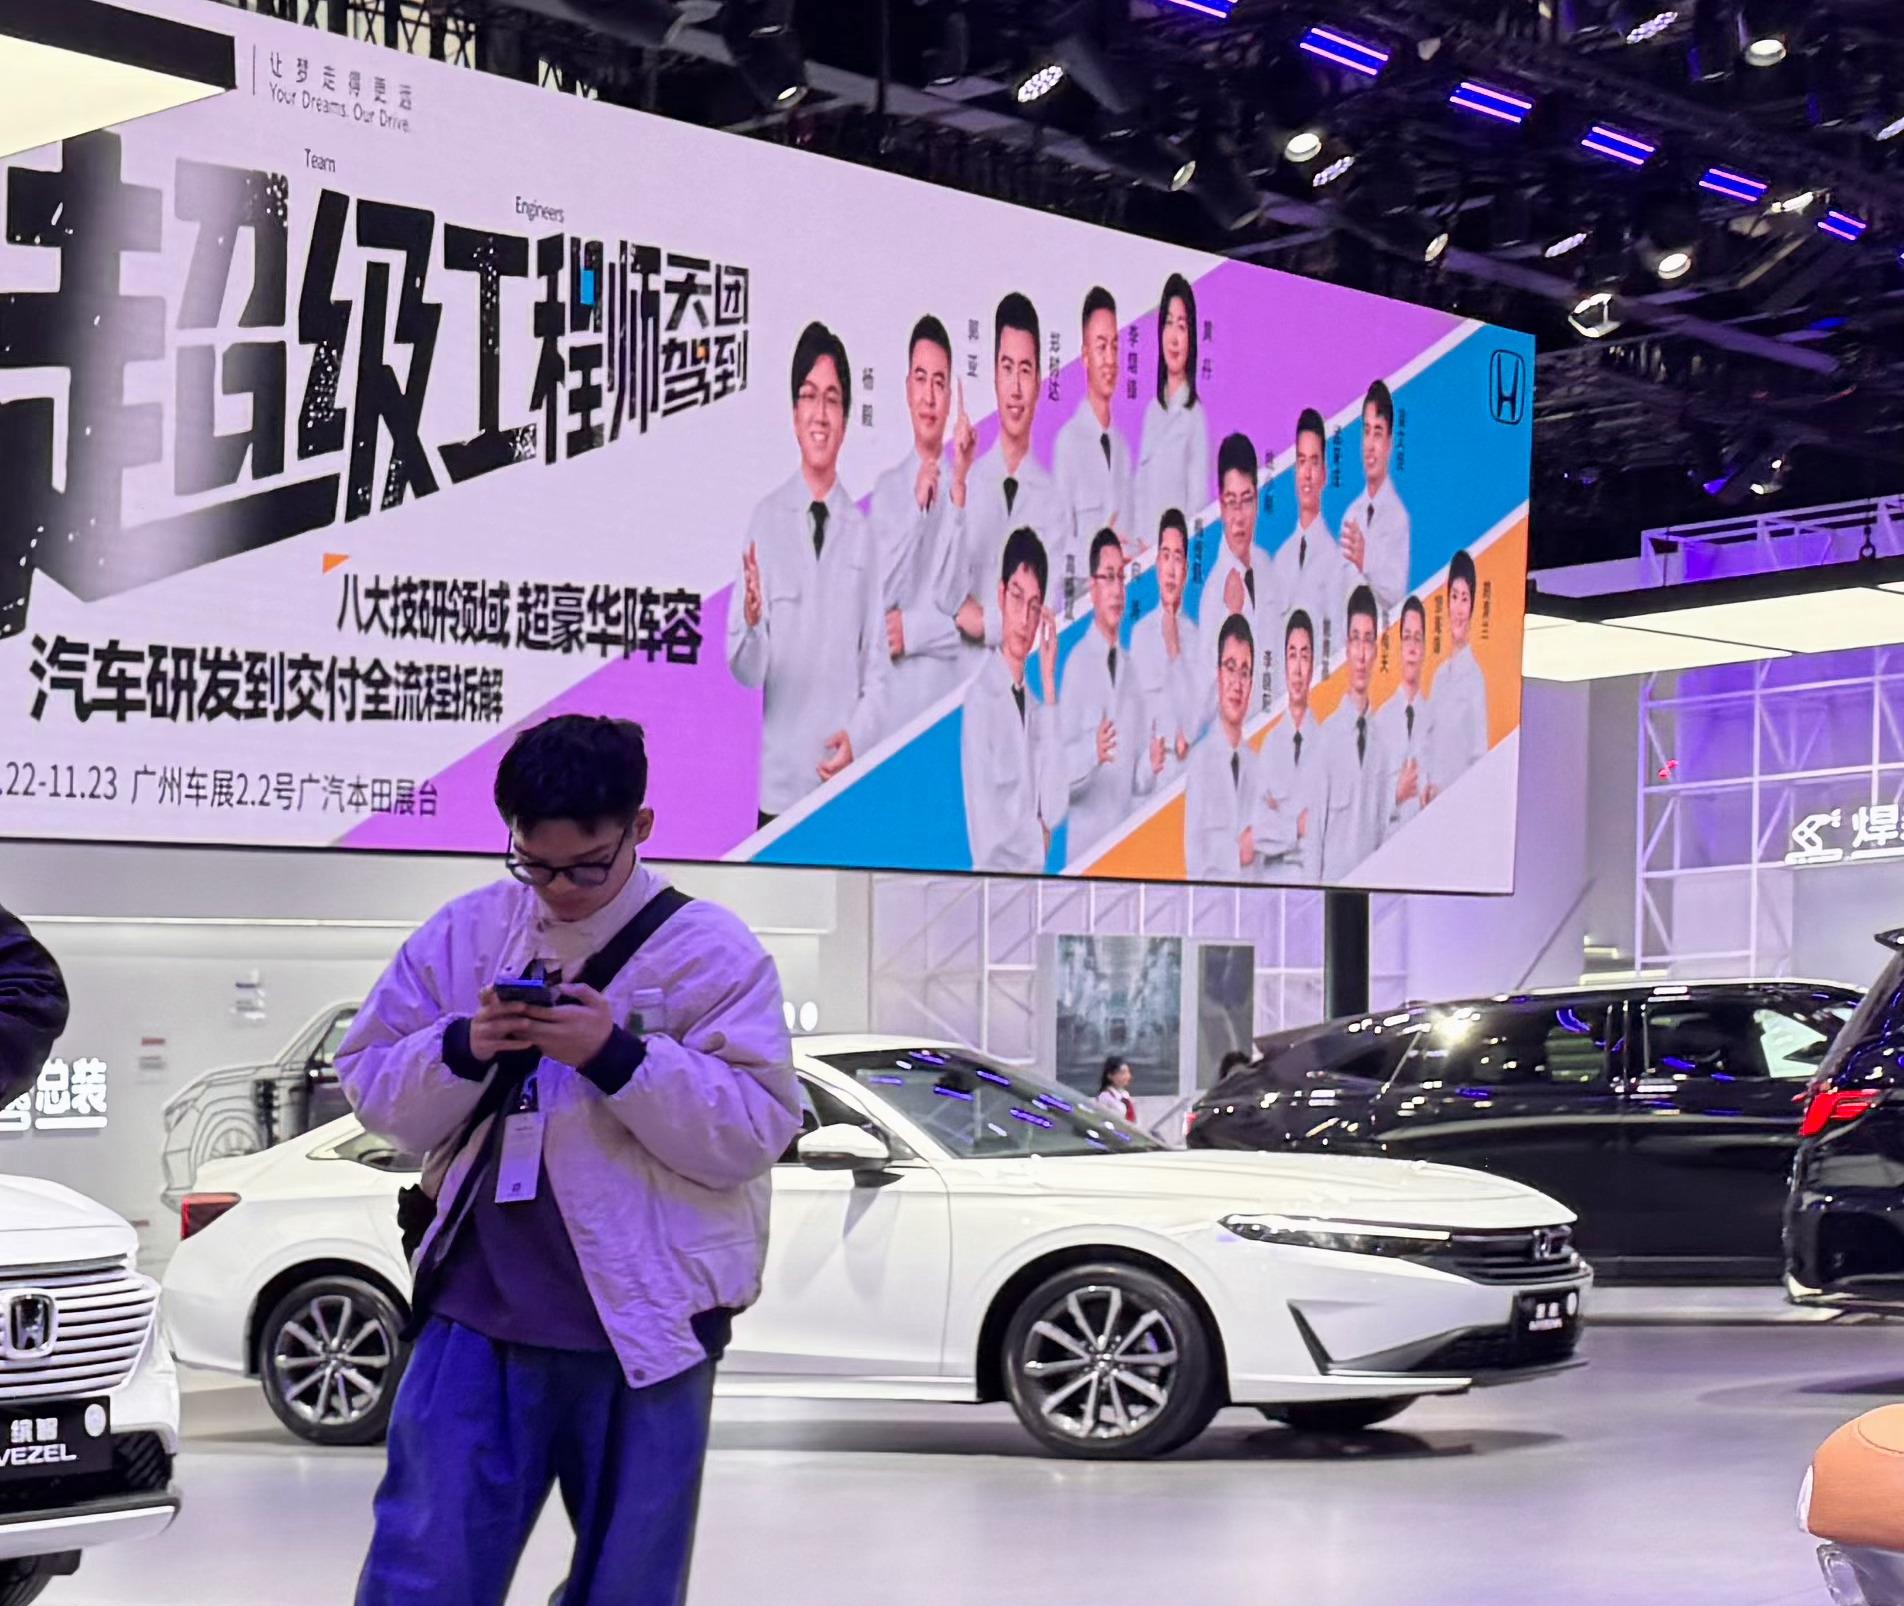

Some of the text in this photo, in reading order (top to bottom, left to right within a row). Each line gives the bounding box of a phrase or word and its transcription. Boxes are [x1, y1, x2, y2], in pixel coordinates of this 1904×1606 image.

[269, 81, 297, 105] Your
[304, 147, 336, 173] Team
[515, 196, 565, 224] Engineers
[336, 573, 703, 666] 八大技研领域 超豪华阵容
[29, 633, 504, 723] 汽车研发到交付全流程拆解
[1851, 803, 1904, 848] 焊
[35, 1057, 108, 1116] 总装
